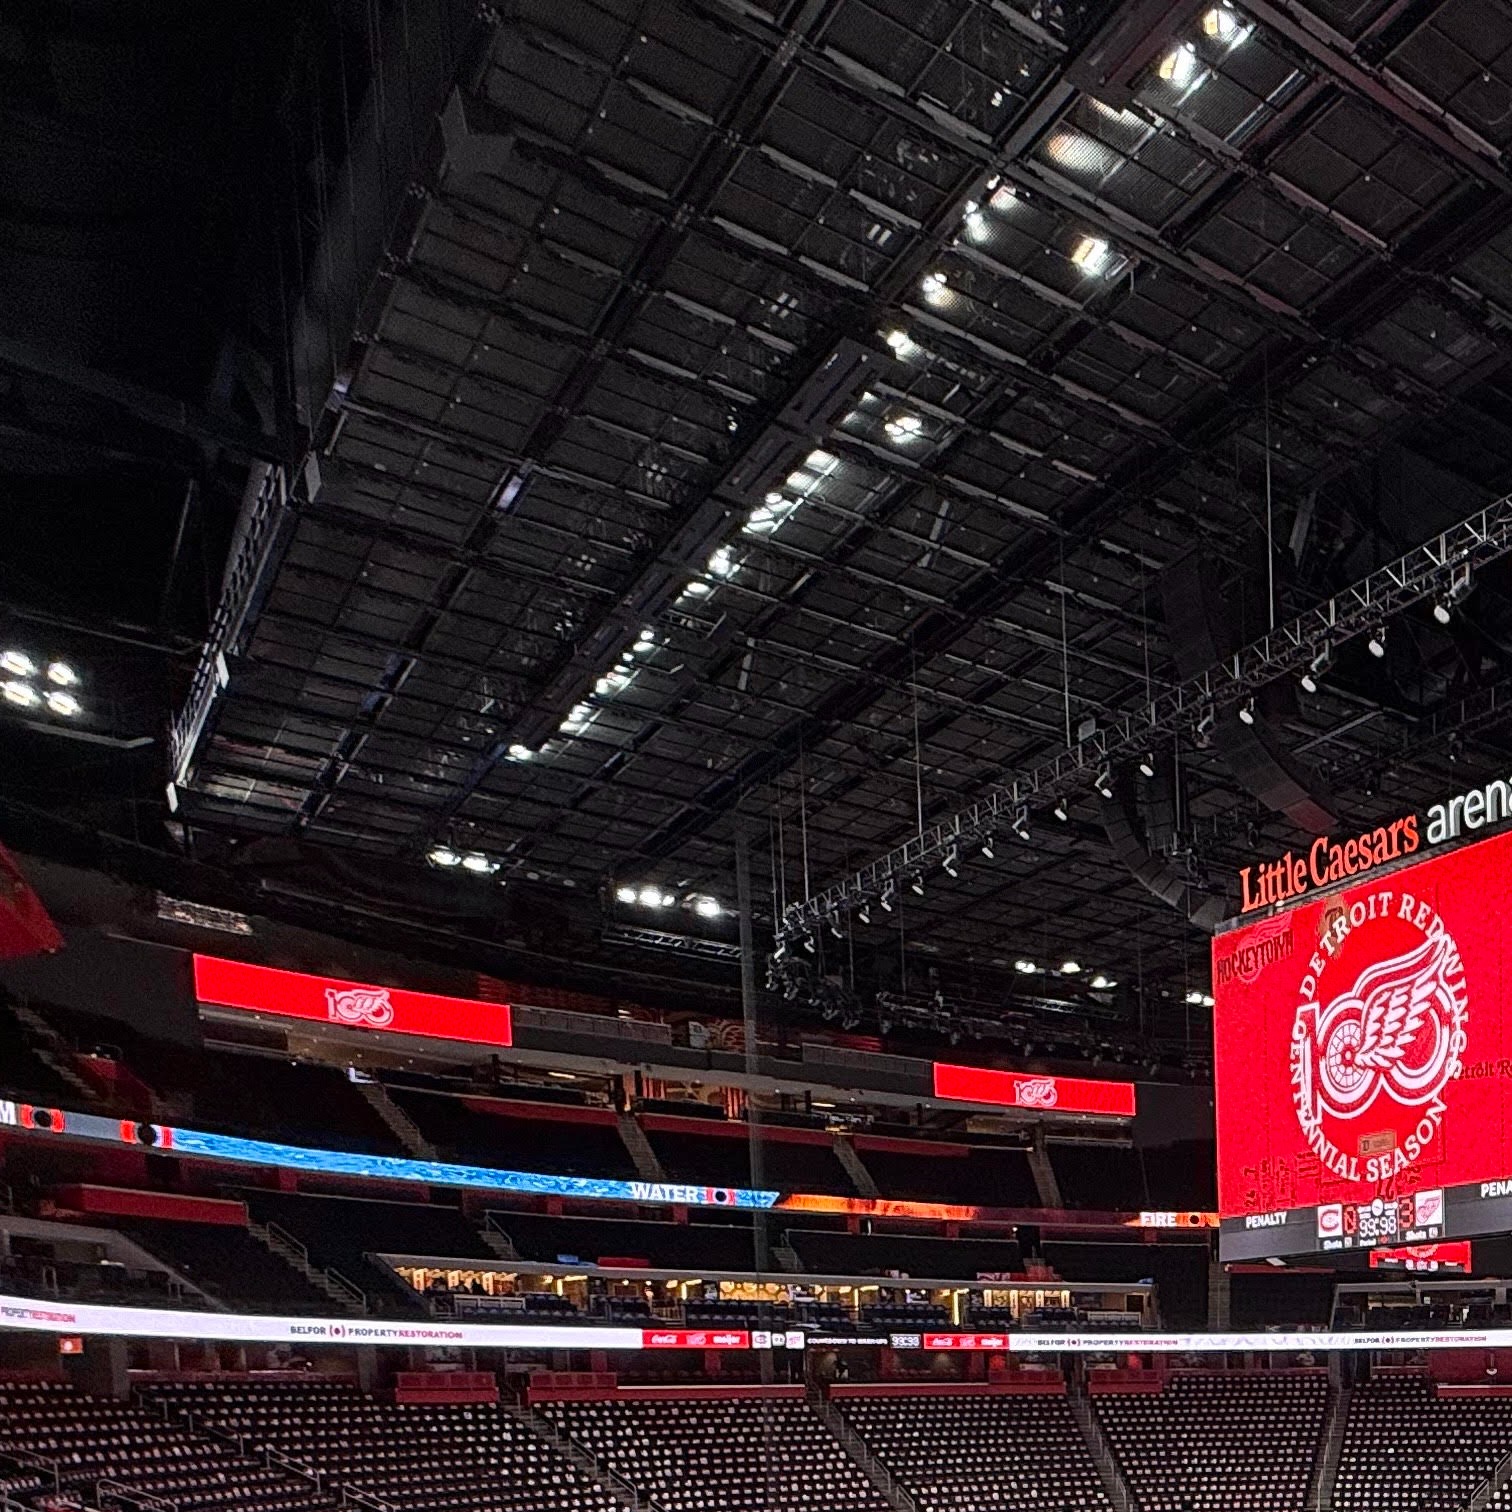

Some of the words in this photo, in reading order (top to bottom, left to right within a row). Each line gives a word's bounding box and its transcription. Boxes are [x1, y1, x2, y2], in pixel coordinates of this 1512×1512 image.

[1239, 851, 1308, 913] Little
[1310, 813, 1419, 887] Caesars
[1217, 928, 1293, 984] HOCKEYTOWN
[1300, 891, 1393, 1000] DETROIT
[1397, 893, 1445, 940] RED
[1366, 1096, 1447, 1183] SEASON
[632, 1182, 697, 1202] WATER
[1141, 1212, 1176, 1227] FIRE
[1246, 1211, 1287, 1229] PENALTY
[290, 1326, 326, 1335] BELFOR
